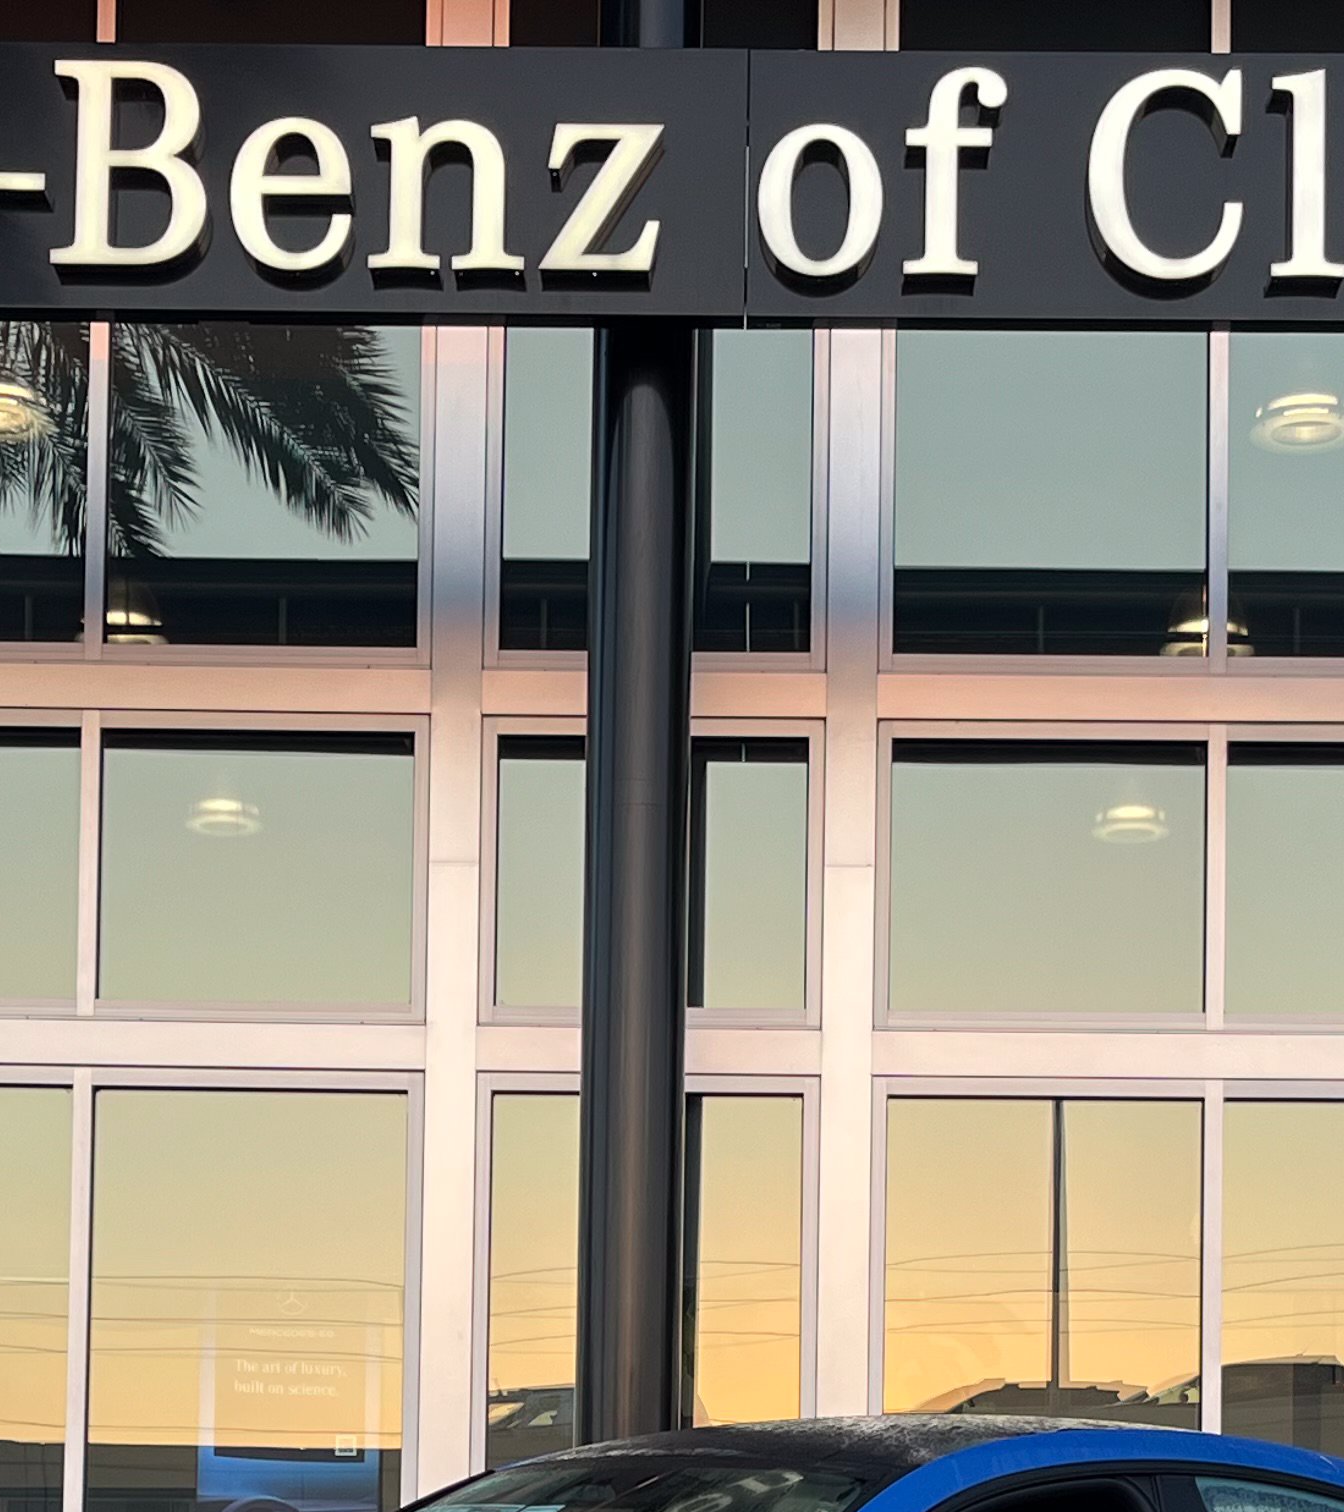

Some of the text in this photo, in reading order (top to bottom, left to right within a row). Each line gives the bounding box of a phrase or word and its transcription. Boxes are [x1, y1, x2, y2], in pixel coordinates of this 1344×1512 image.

[757, 66, 1009, 278] of
[233, 1358, 260, 1373] The
[262, 1361, 281, 1374] art
[284, 1360, 298, 1375] of
[233, 1378, 265, 1394] built
[267, 1383, 285, 1395] on
